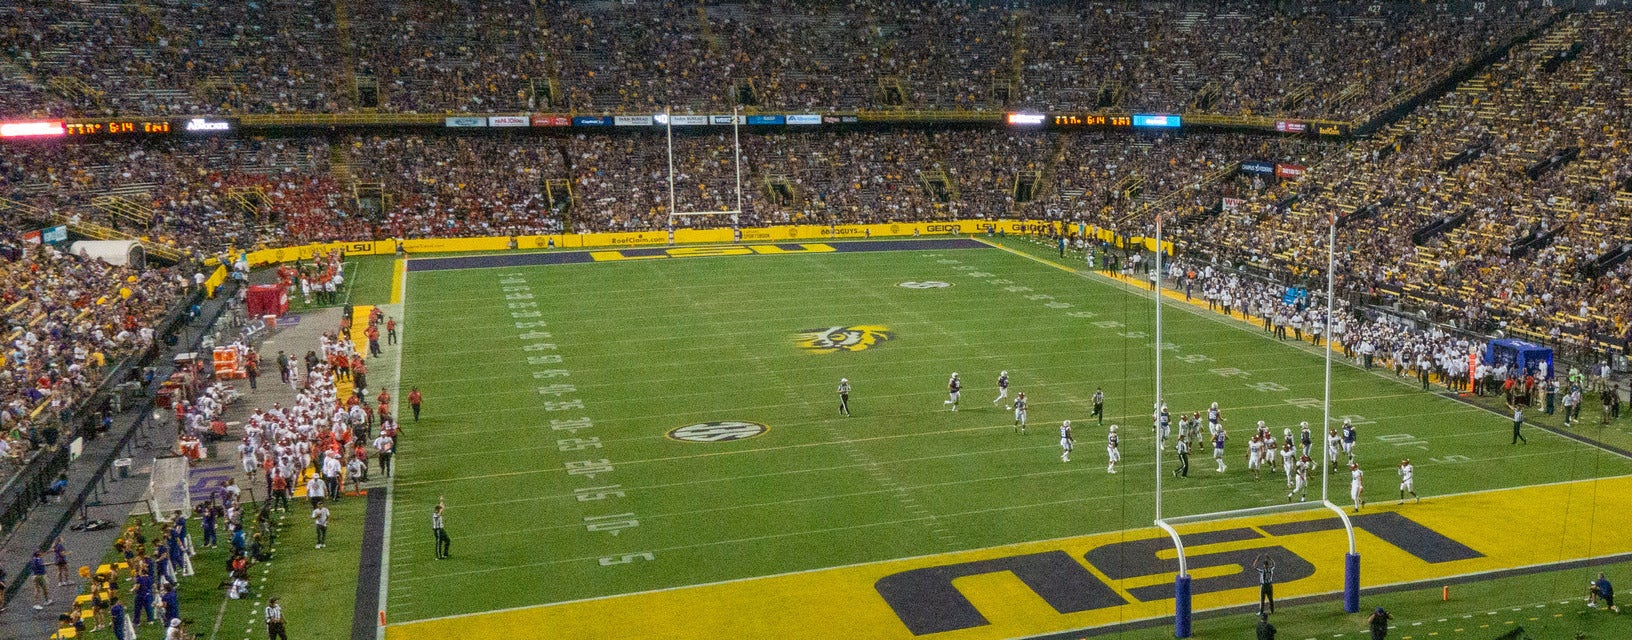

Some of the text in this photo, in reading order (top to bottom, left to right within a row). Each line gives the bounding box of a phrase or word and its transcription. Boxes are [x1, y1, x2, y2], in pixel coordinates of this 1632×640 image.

[1087, 115, 1105, 125] 6:14
[109, 122, 134, 133] 6:14
[926, 224, 961, 233] GEICO
[976, 223, 997, 231] LSU
[611, 236, 665, 244] RoofClaim.com
[345, 243, 371, 253] LSU
[589, 244, 837, 262] LSU
[583, 513, 640, 531] 10
[598, 552, 655, 566] 5
[874, 511, 1486, 636] LSU
